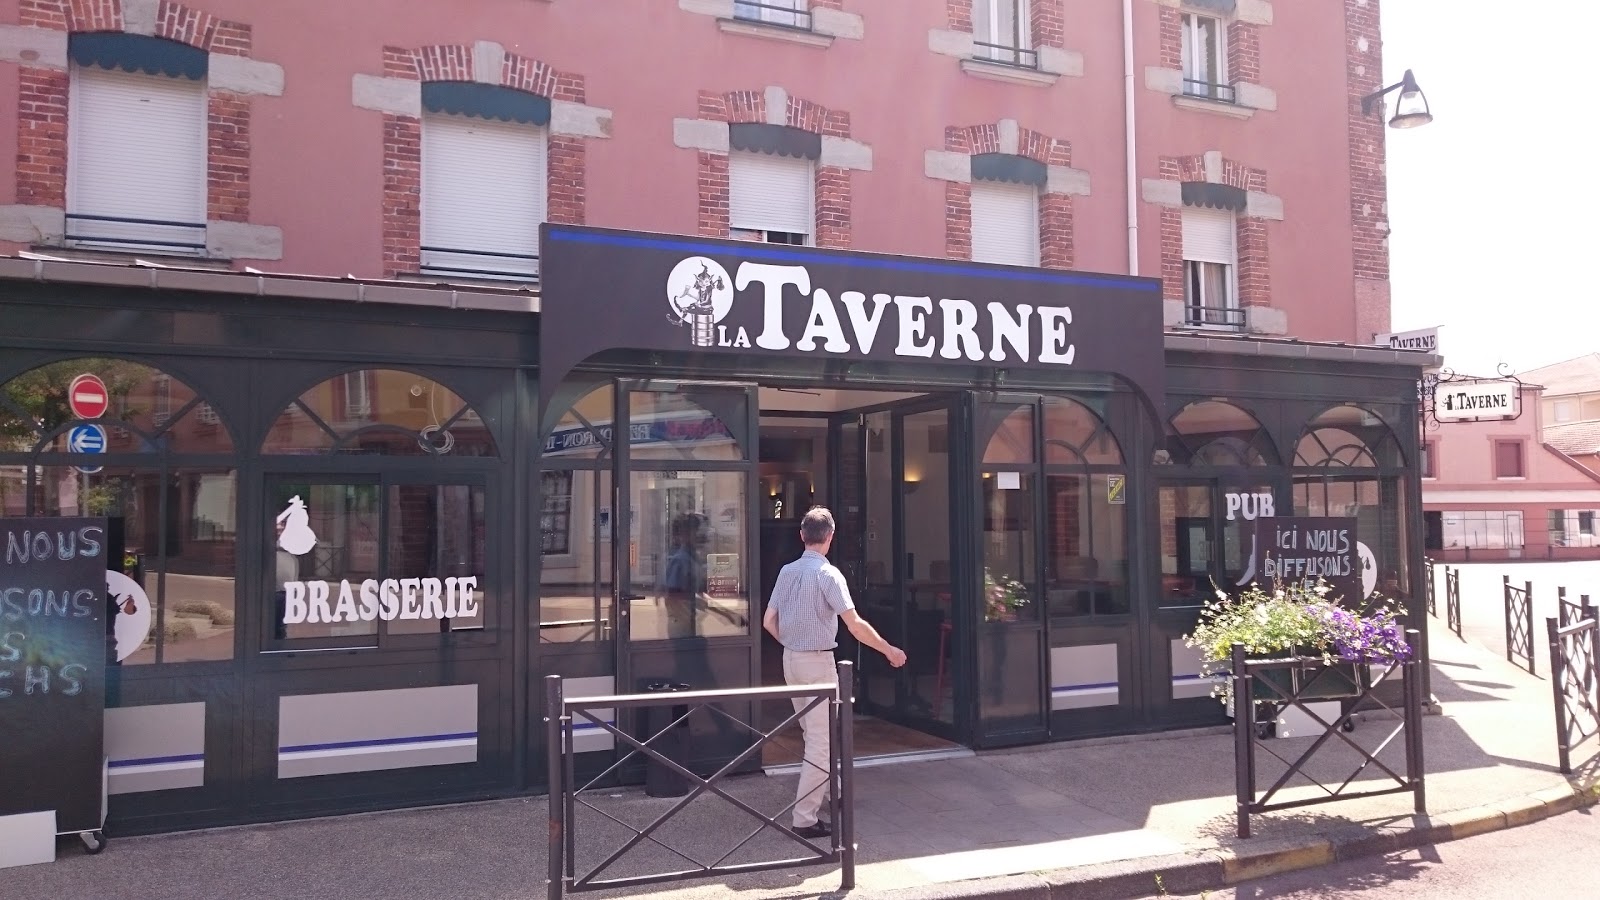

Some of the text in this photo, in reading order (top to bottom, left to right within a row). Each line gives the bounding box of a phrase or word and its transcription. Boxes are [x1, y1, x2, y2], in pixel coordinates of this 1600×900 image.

[718, 261, 1075, 365] LA TAVERNE
[1390, 335, 1435, 350] TAVERNE
[1457, 393, 1507, 410] TAVERNE
[1225, 493, 1275, 520] PUB
[6, 526, 104, 564] NOUS
[1306, 529, 1350, 554] NOUS
[0, 587, 95, 621] SONS
[282, 575, 479, 625] BRASSERIE
